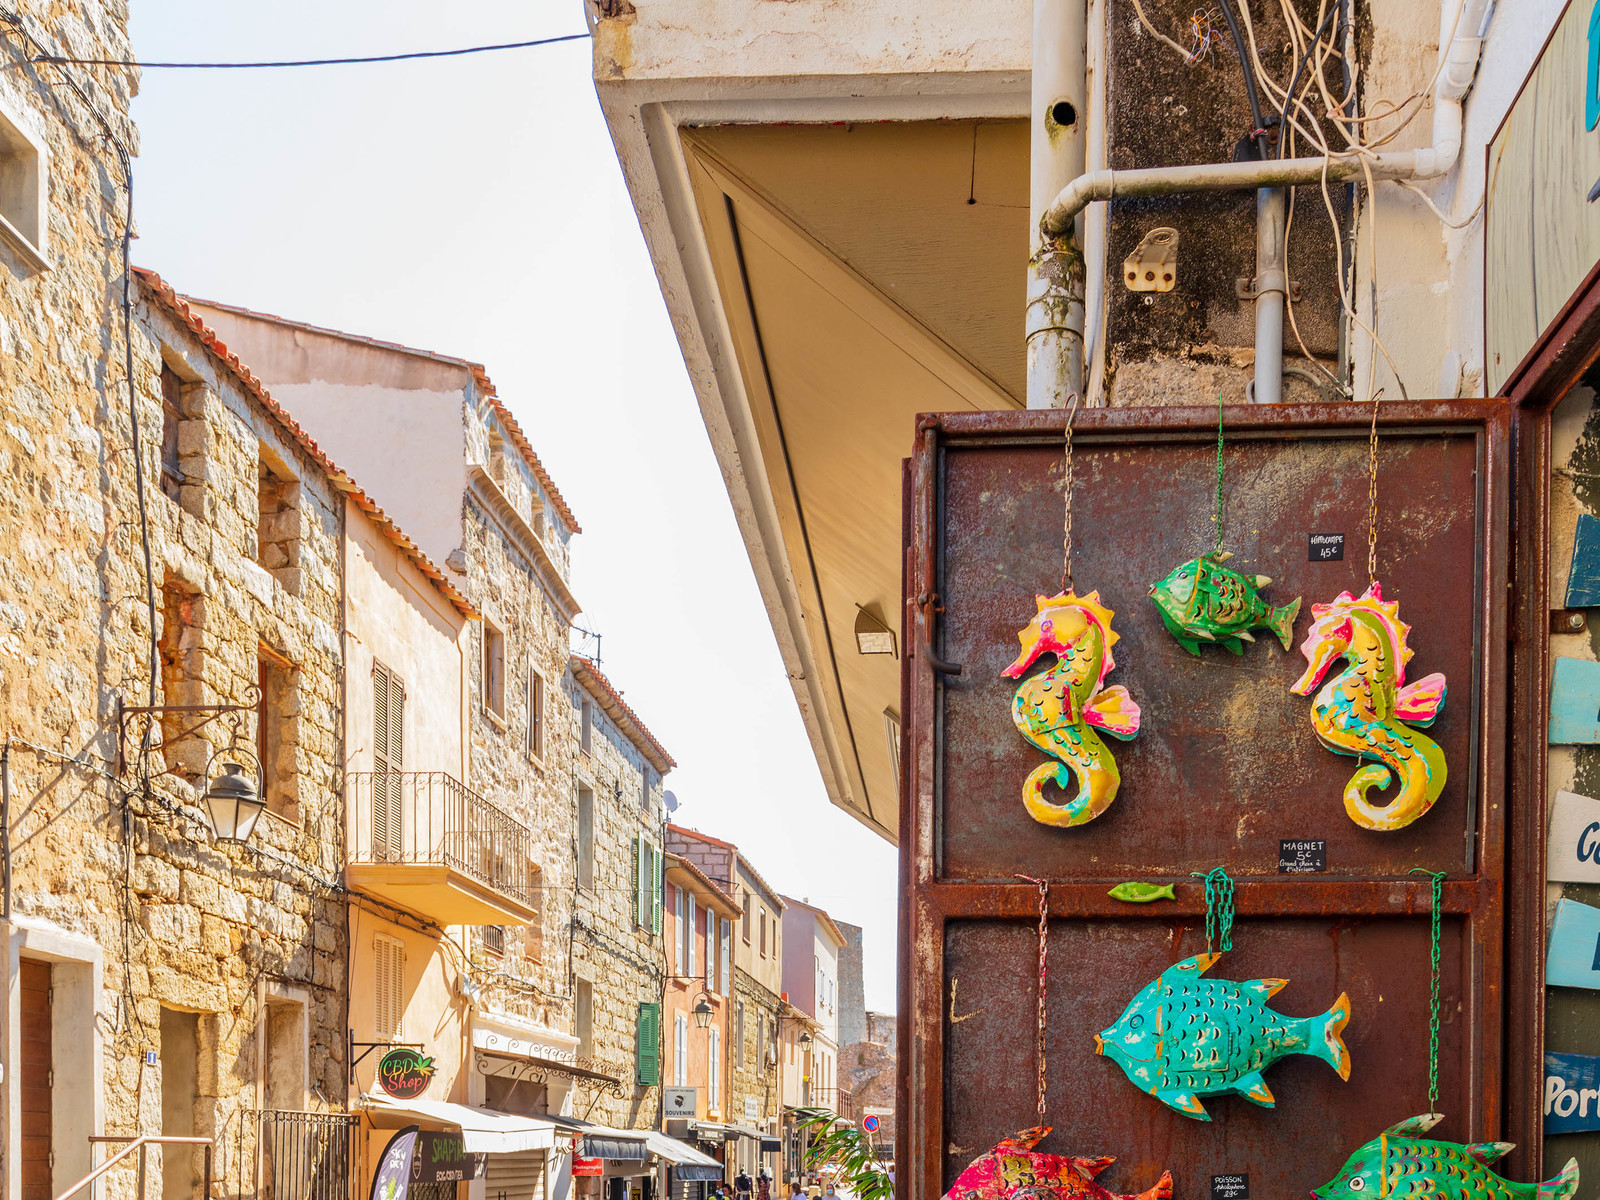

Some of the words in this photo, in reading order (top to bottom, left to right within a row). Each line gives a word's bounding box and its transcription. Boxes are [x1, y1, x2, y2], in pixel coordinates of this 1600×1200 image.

[1320, 546, 1338, 559] 45€
[1283, 841, 1325, 851] MAGNET
[383, 1057, 414, 1077] CBD
[388, 1073, 423, 1092] Shop
[1543, 1075, 1600, 1119] Por
